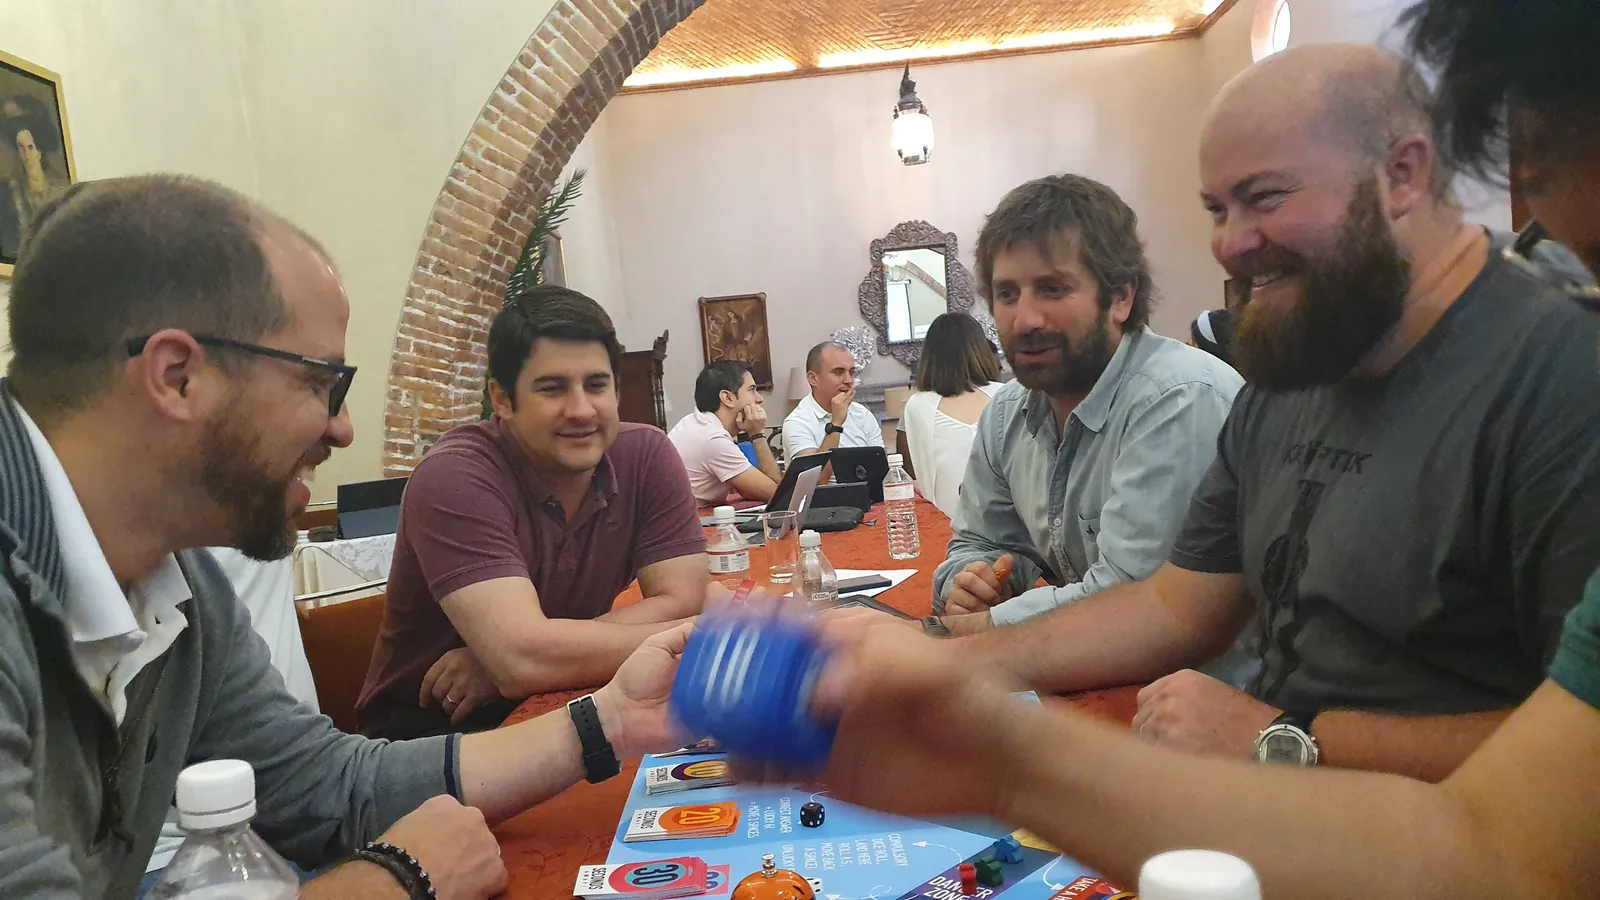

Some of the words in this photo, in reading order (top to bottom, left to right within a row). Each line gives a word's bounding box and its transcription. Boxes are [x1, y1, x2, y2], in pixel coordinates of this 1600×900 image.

[640, 810, 658, 830] SECONDS
[680, 808, 721, 824] 20
[780, 816, 793, 834] ANSWER
[782, 844, 795, 867] UNLUCKY
[821, 842, 835, 858] MOVE
[888, 833, 909, 867] COMPULSORY
[588, 867, 607, 890] SECONDS
[631, 864, 680, 885] 30
[1068, 877, 1099, 892] TAKE
[928, 876, 993, 899] DANER
